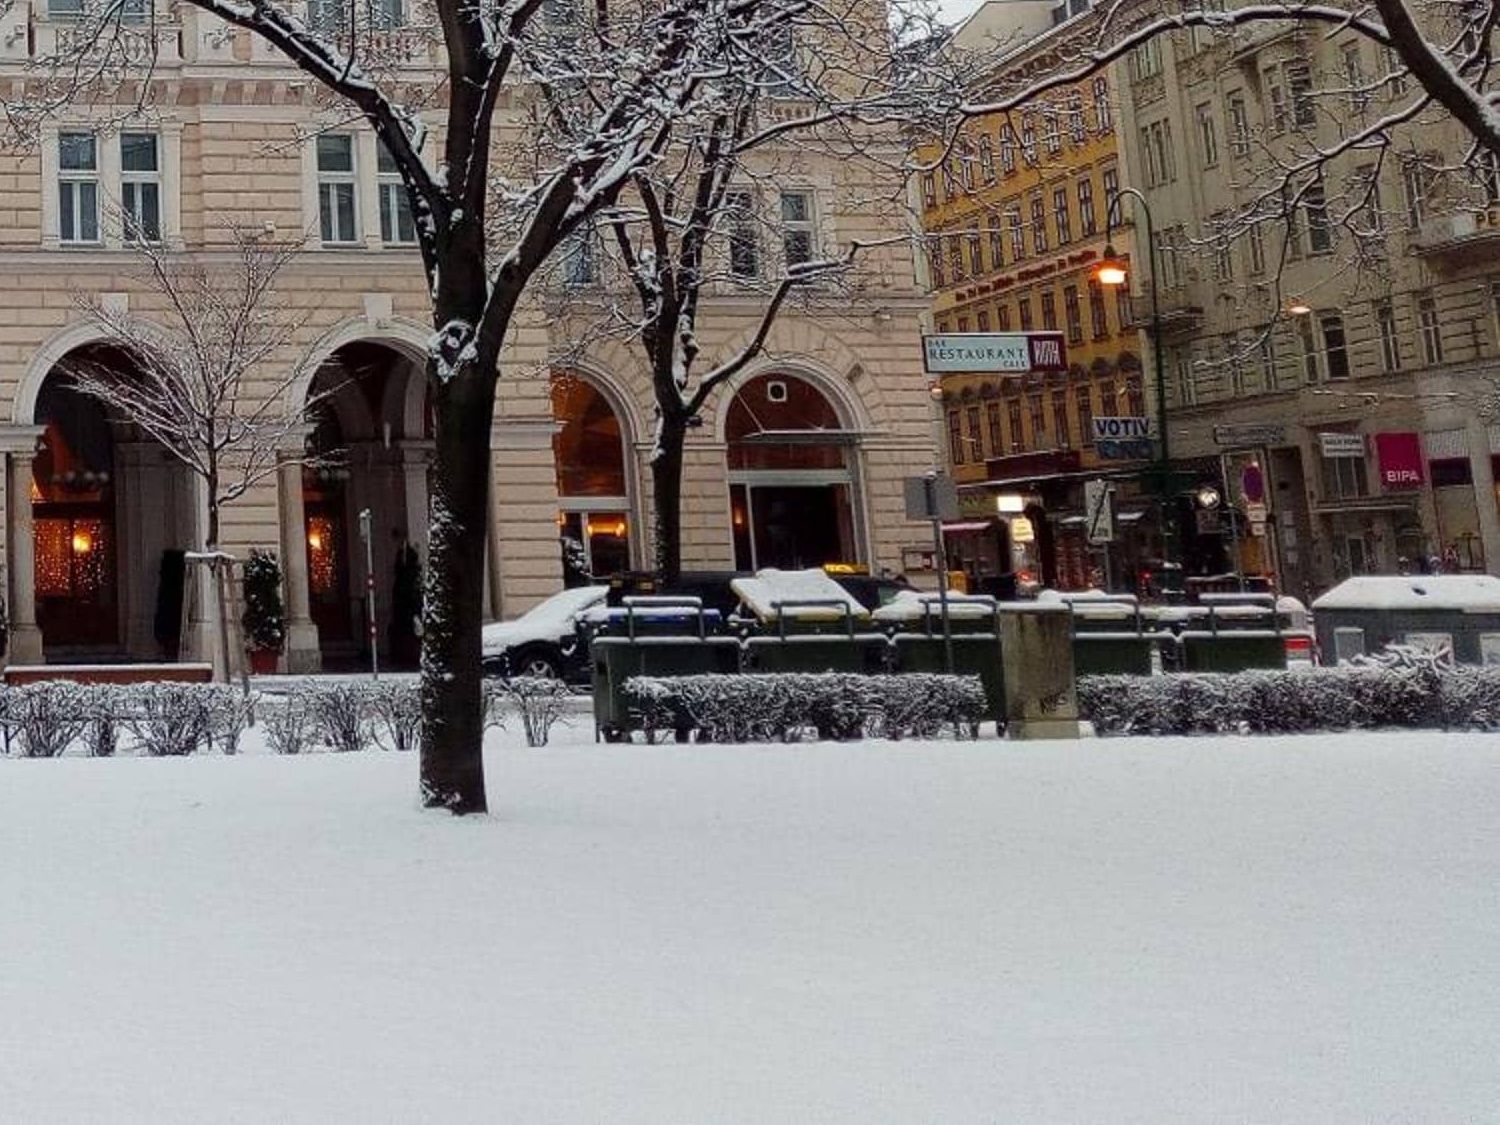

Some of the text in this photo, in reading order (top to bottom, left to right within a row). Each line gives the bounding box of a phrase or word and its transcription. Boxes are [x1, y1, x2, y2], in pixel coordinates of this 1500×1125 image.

[930, 348, 1024, 360] RESTAURANT
[1096, 418, 1149, 435] VOTIV
[1387, 470, 1419, 482] BIPA
